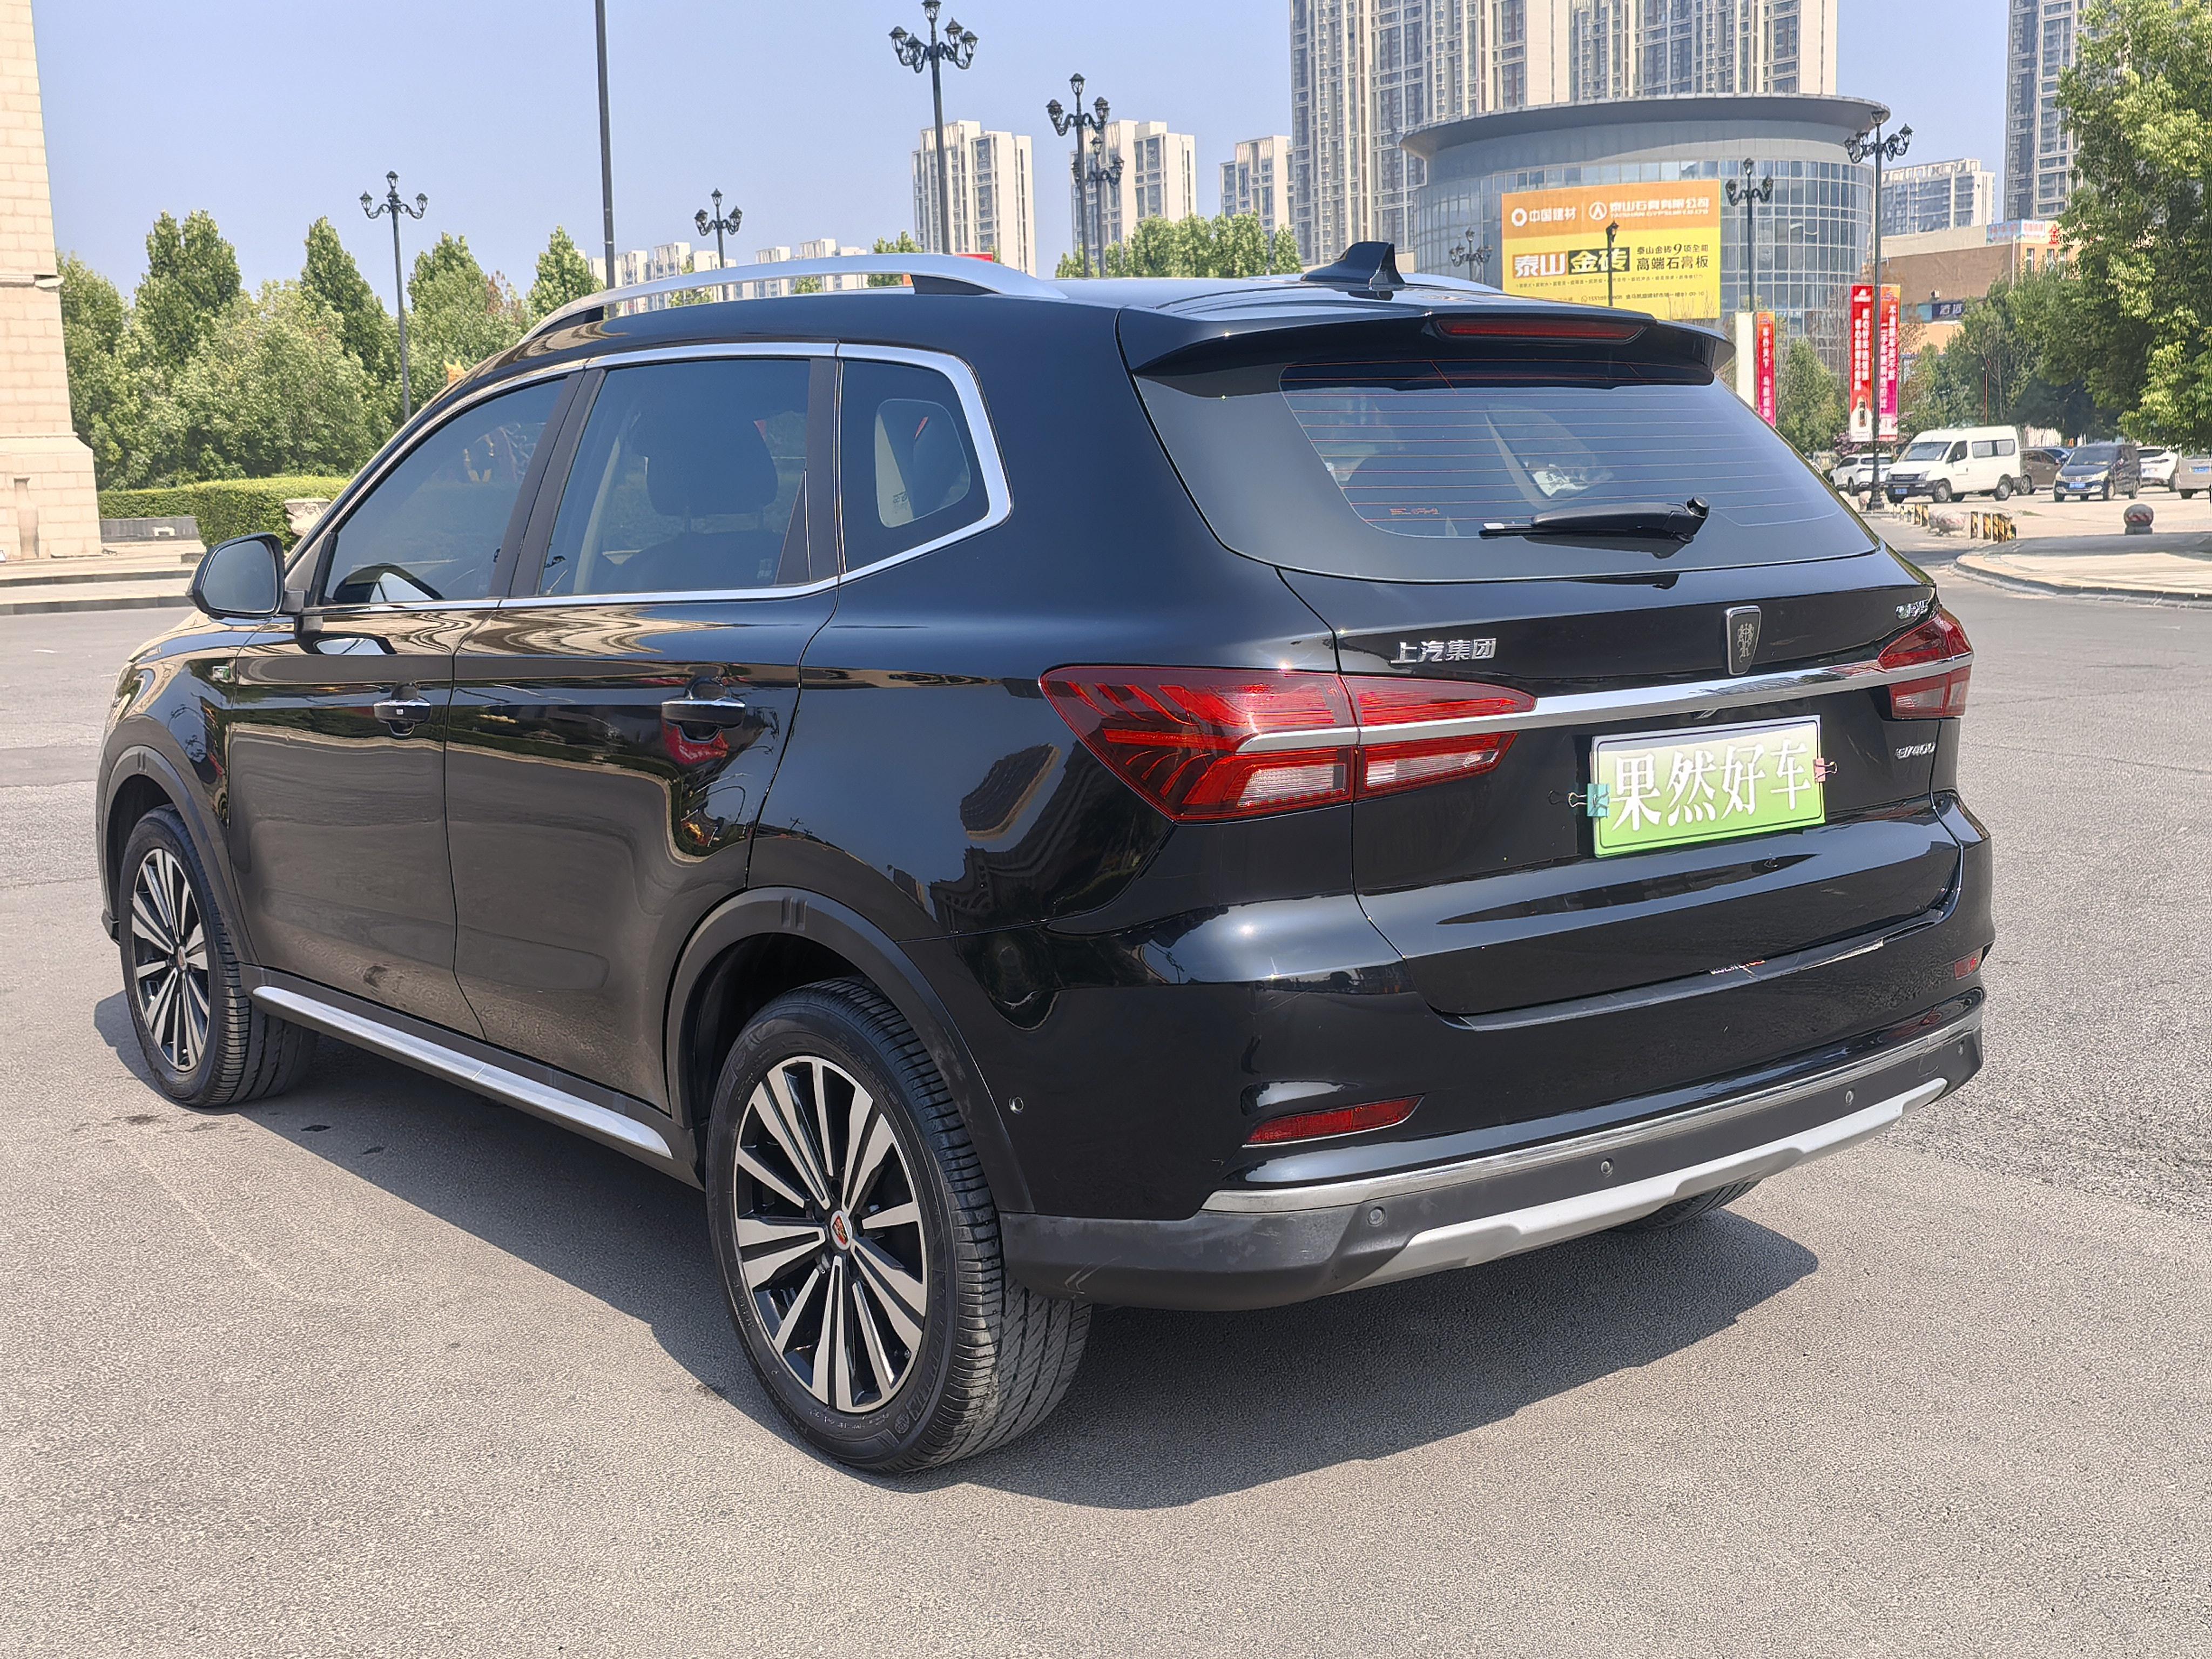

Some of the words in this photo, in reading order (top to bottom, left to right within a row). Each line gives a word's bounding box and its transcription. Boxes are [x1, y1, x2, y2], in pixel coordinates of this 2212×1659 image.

[1529, 207, 1576, 222] 中国建材
[1636, 255, 1708, 271] 高端石膏板
[1390, 638, 1496, 664] 上汽集团
[1610, 738, 1811, 832] 果然好车
